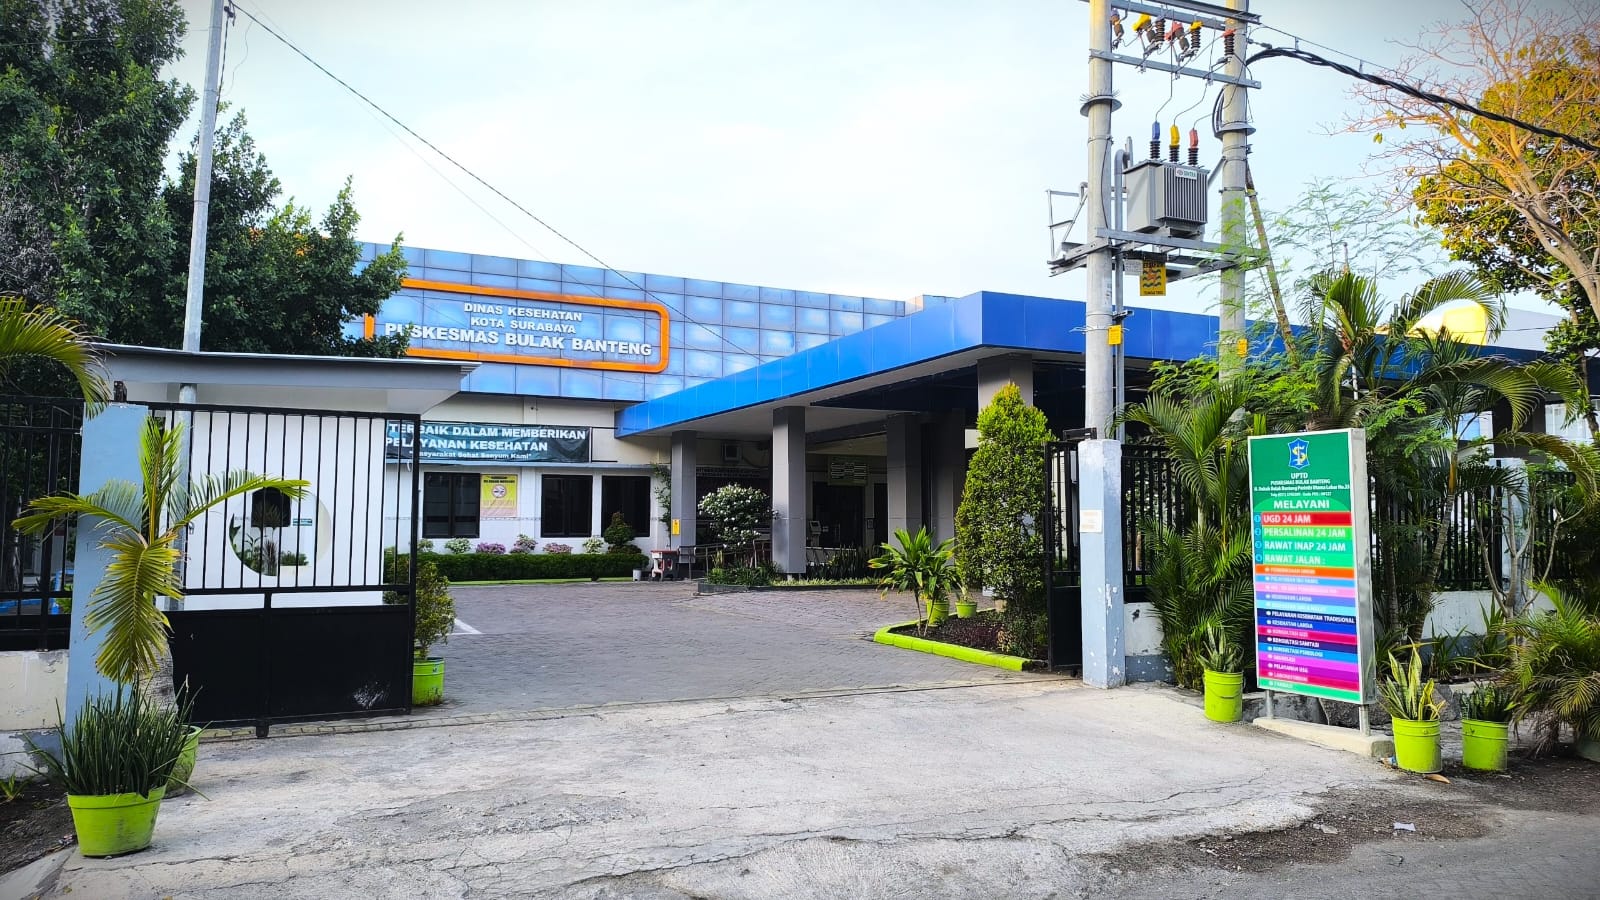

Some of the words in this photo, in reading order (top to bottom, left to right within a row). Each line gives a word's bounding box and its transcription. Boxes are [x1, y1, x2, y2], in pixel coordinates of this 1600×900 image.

[464, 303, 503, 315] DINAS
[508, 307, 582, 322] KESEHATAN
[470, 316, 505, 328] KOTA
[510, 320, 576, 334] SURABAYA
[505, 333, 566, 350] BULAK
[572, 337, 652, 356] BANTENG
[452, 426, 499, 437] DALAM
[501, 428, 586, 440] MEMBERIKAN
[470, 440, 548, 451] KESEHATAN
[1274, 500, 1330, 509] MELAYANI
[1294, 515, 1311, 523] JAM
[1264, 528, 1314, 536] PERSALINAN
[1328, 529, 1346, 537] JAM
[1264, 542, 1292, 550] RAWAT
[1294, 542, 1314, 550] INAP
[1328, 543, 1346, 552] JAM
[1264, 554, 1292, 563] RAWAT
[1294, 555, 1320, 564] JALAN
[1324, 616, 1355, 624] TRADISIONAL
